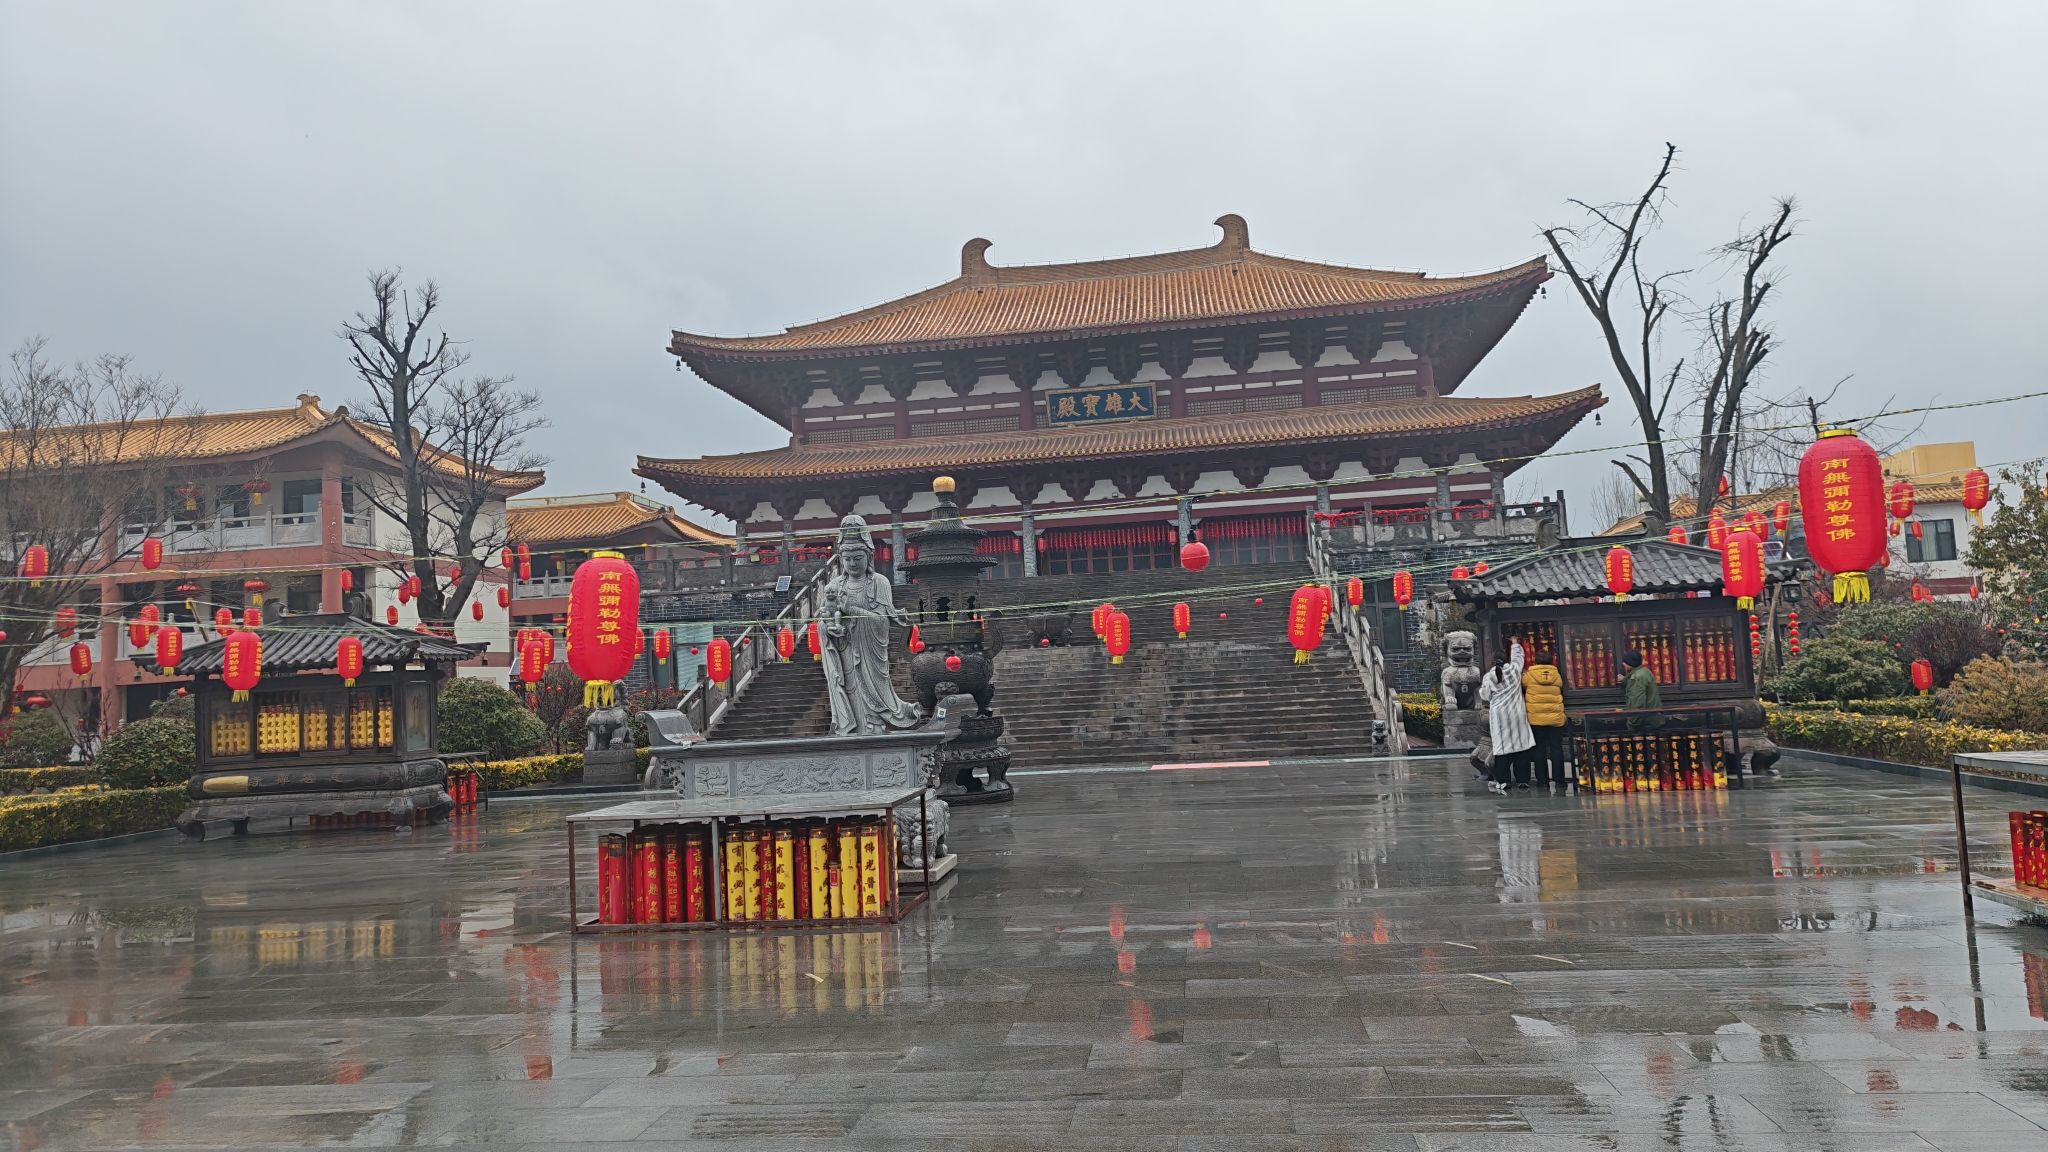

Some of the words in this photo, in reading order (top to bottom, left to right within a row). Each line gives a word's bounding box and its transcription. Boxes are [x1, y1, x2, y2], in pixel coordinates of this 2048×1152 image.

[1820, 458, 1856, 542] 南無彌勒尊佛
[597, 571, 622, 645] 南無彌勒尊佛
